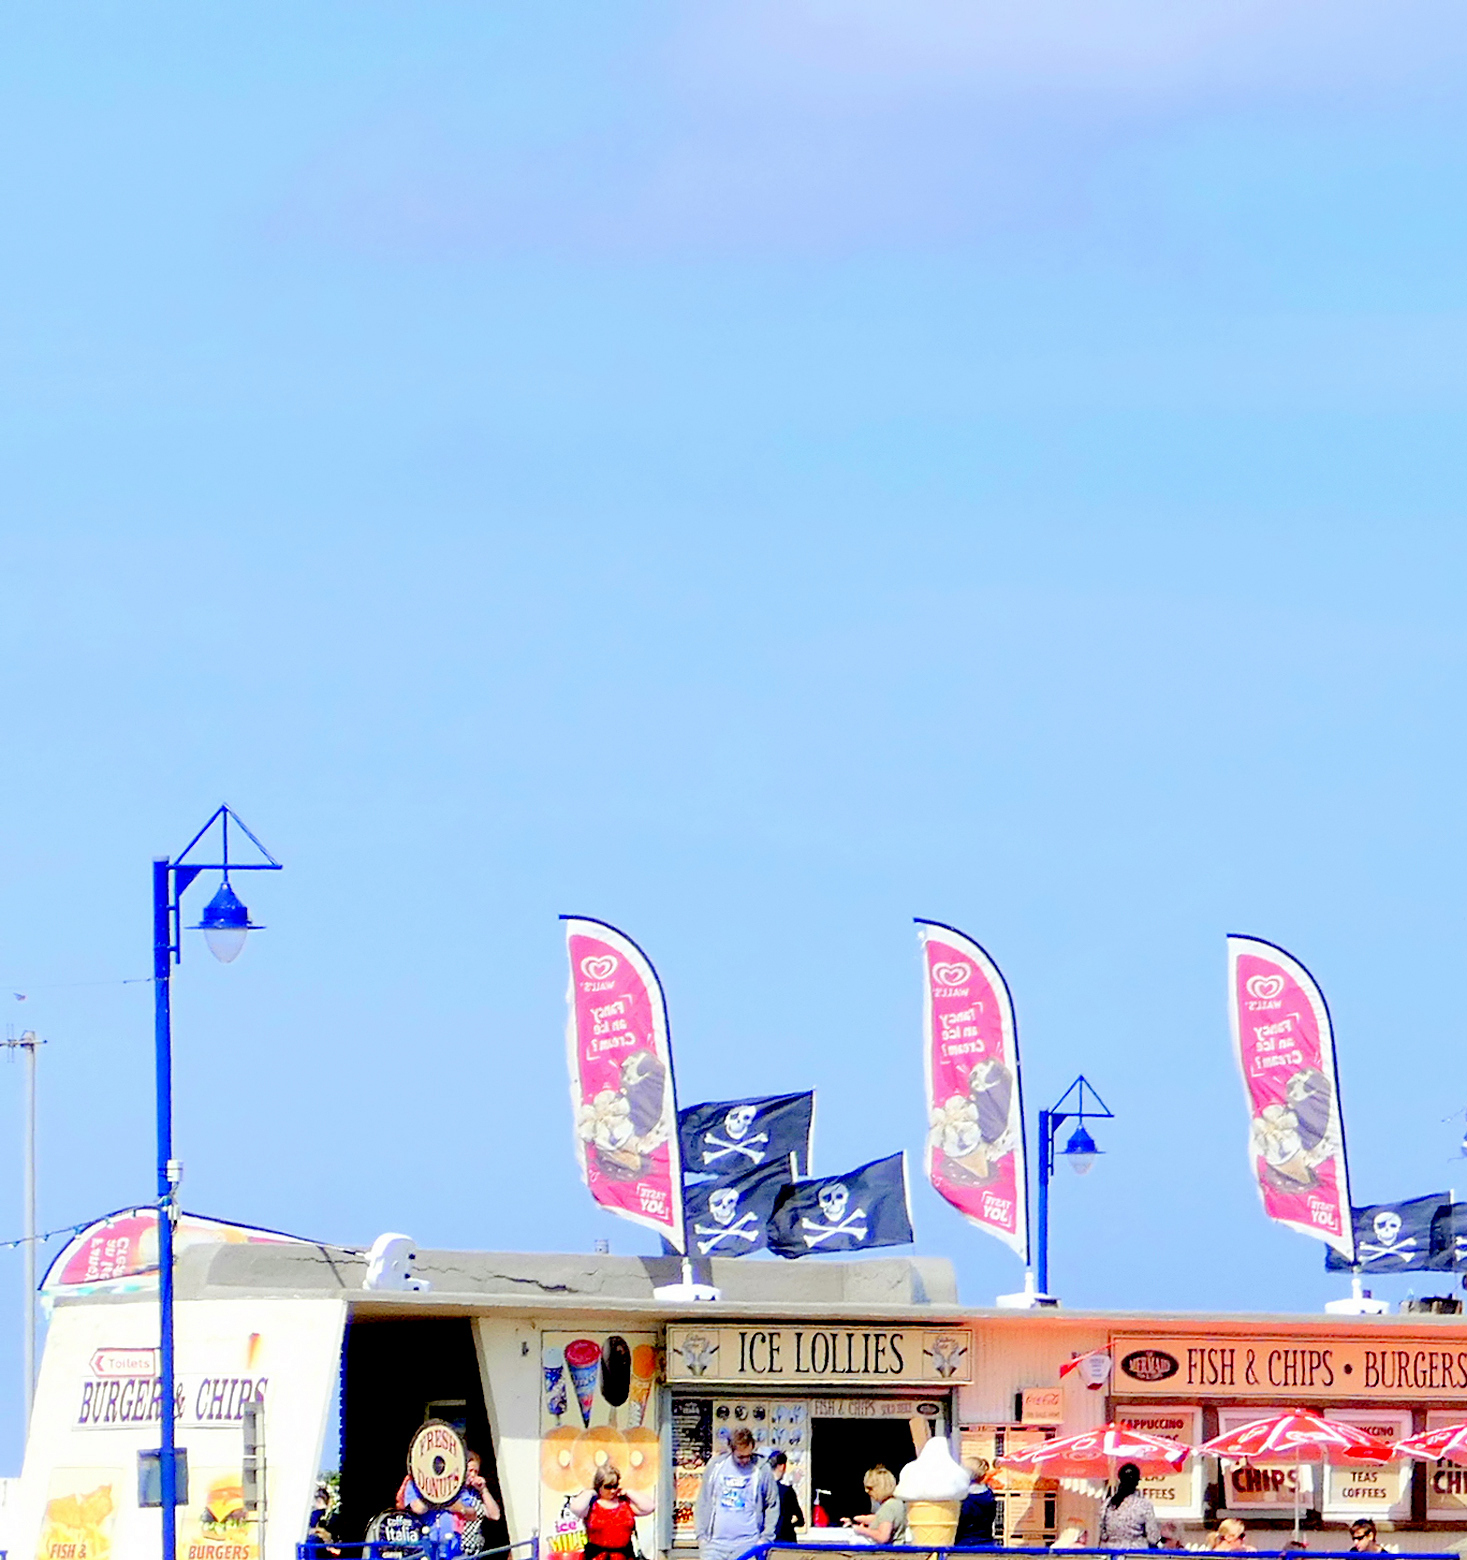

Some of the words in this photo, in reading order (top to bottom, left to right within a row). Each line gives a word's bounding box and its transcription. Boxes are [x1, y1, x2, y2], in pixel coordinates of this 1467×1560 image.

[738, 1331, 783, 1373] ICE
[795, 1331, 904, 1374] LOLLIES
[109, 1358, 150, 1370] Toilets
[1187, 1348, 1235, 1385] FISH
[1246, 1349, 1259, 1384] &
[1268, 1350, 1334, 1387] CHIPS
[418, 1429, 457, 1456] FRESH
[417, 1467, 459, 1498] DONUTS
[1232, 1467, 1299, 1494] CHIPS
[1351, 1471, 1377, 1483] TEAS
[1342, 1488, 1387, 1499] COFFEES
[386, 1526, 419, 1543] Italia
[50, 1544, 75, 1559] FISH
[189, 1545, 250, 1560] BURGERS
